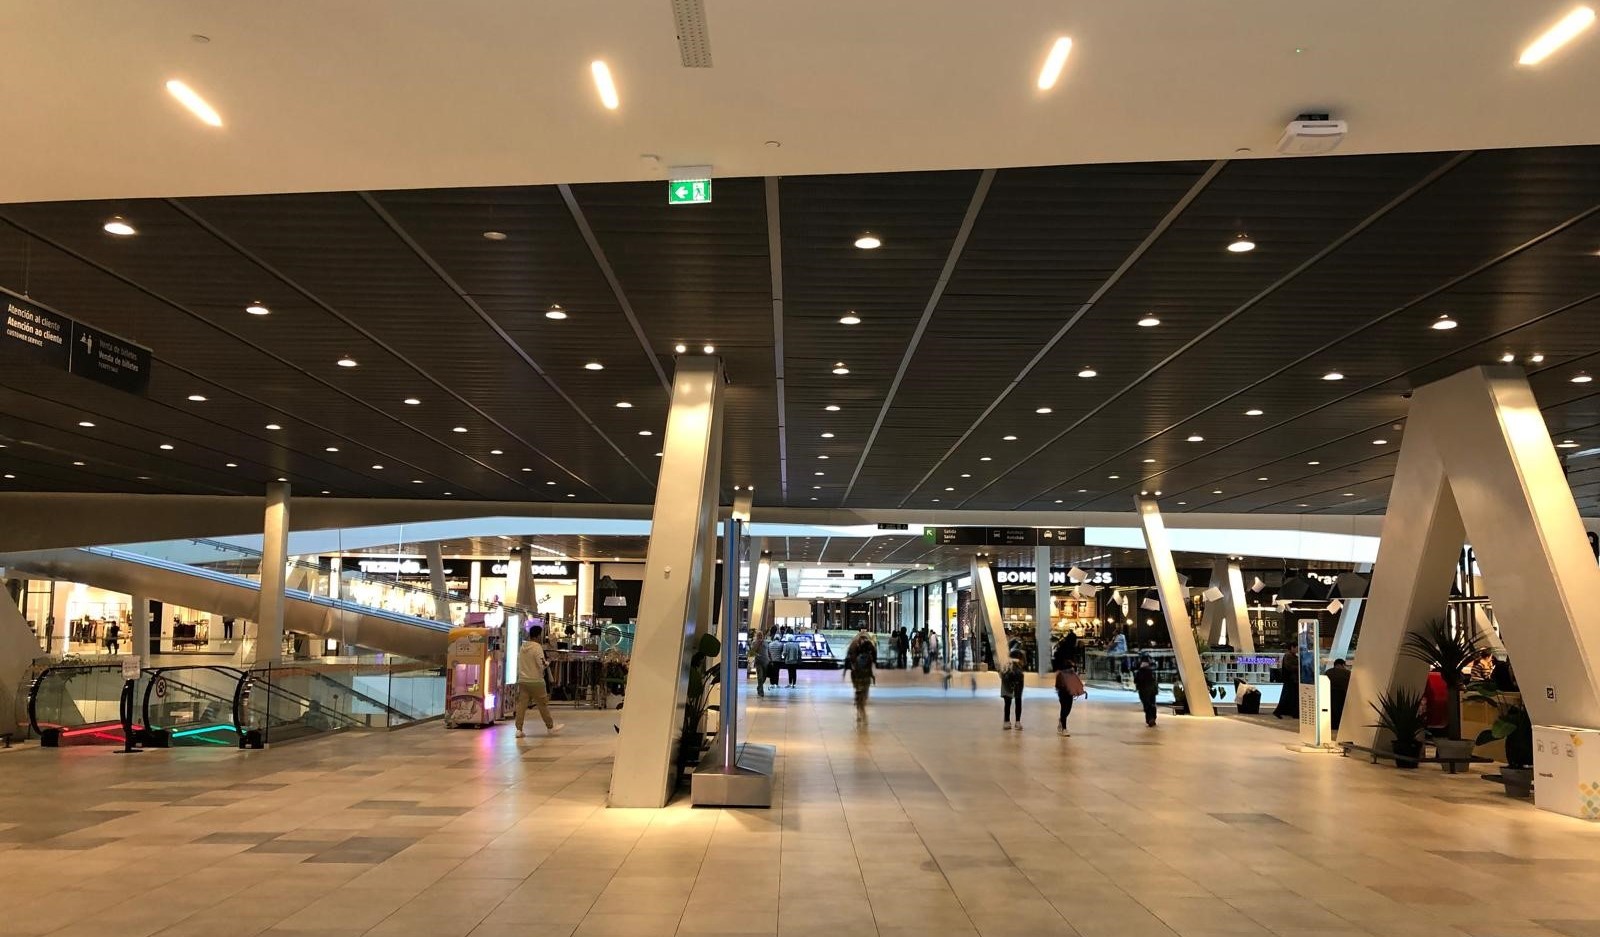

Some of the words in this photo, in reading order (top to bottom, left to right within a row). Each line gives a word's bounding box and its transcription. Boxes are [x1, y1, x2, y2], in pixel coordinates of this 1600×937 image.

[7, 303, 34, 321] Atención
[34, 315, 41, 324] al
[41, 318, 60, 331] cliente
[6, 329, 27, 341] CUSTOMER
[27, 336, 43, 347] SERVICE
[7, 316, 34, 334] Atención
[34, 328, 43, 337] ao
[43, 330, 63, 345] cliente
[98, 350, 114, 363] Venda
[114, 357, 121, 366] de
[121, 358, 139, 372] billetes
[491, 564, 567, 575] CADONIA
[997, 571, 1066, 583] BOMN
